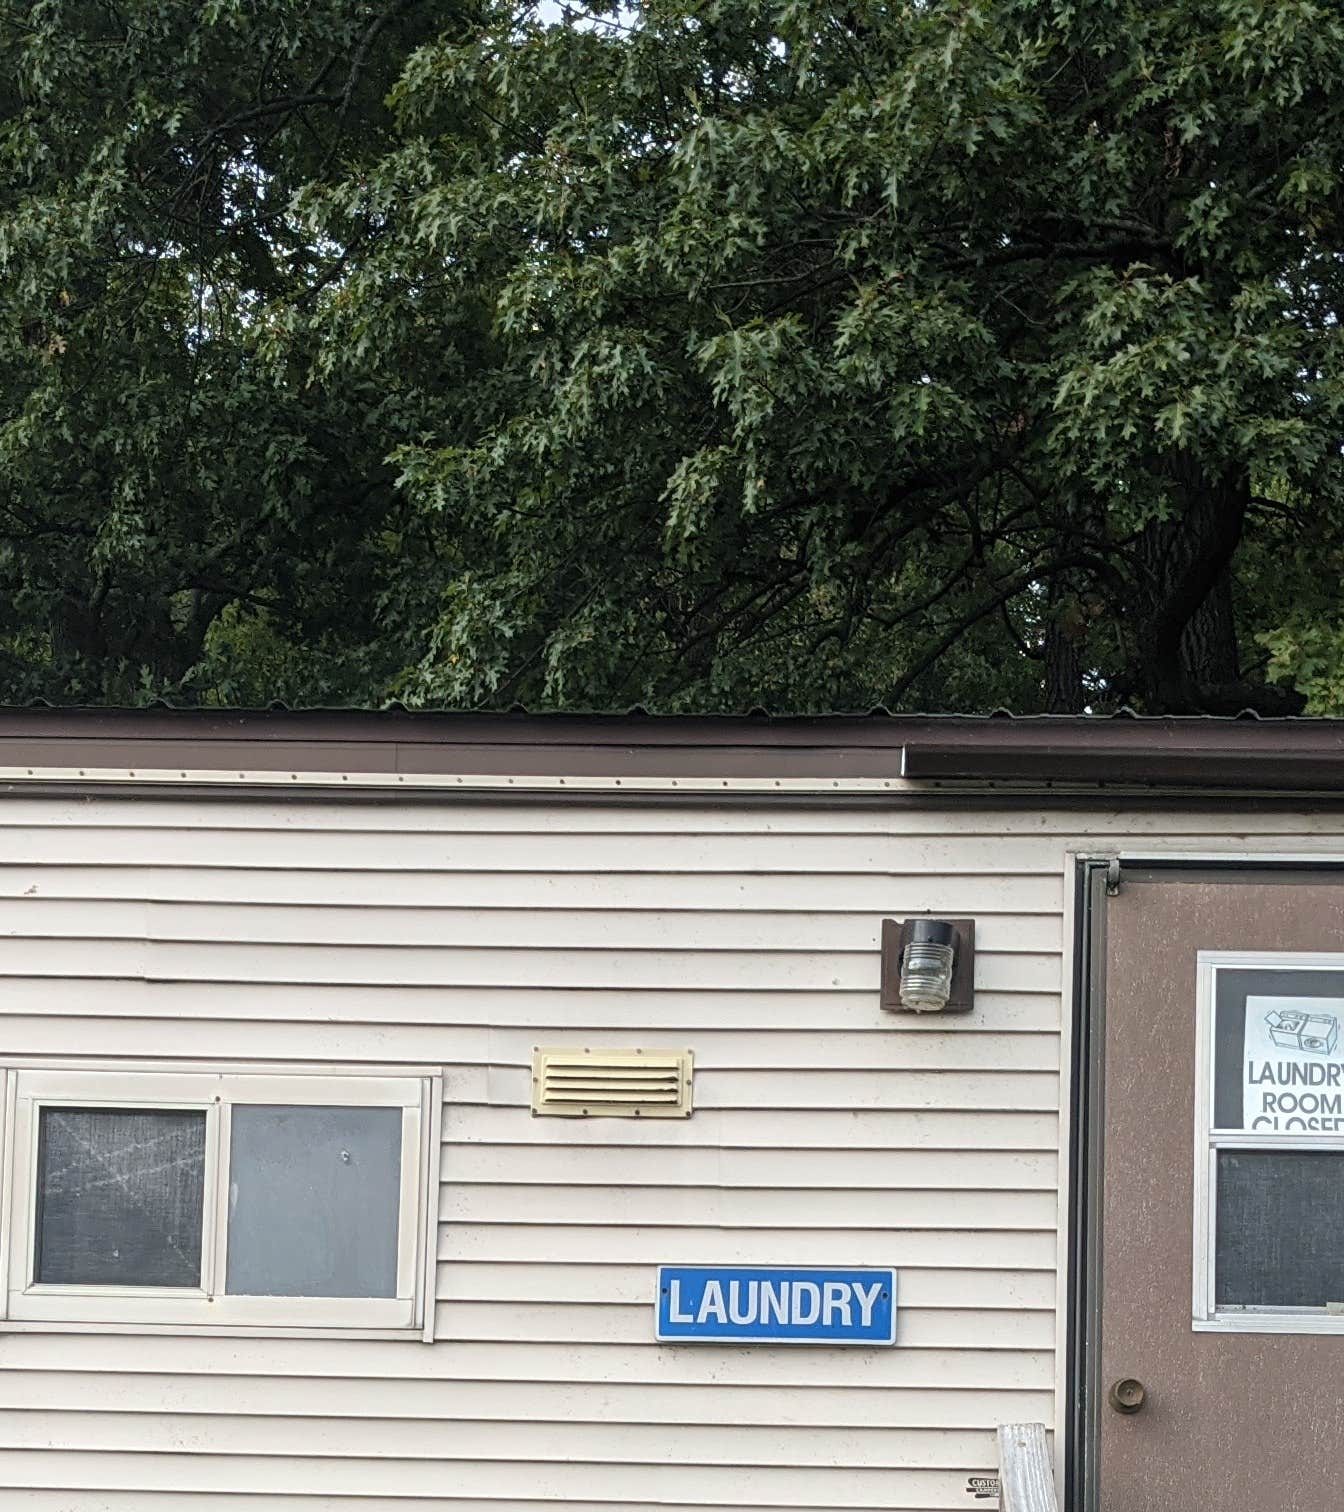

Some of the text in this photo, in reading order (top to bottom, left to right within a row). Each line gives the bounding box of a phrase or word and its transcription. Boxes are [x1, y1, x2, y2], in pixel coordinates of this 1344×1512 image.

[1262, 1092, 1342, 1114] ROOM
[670, 1280, 883, 1326] LAUNDRY
[971, 1479, 999, 1487] CUSTO
